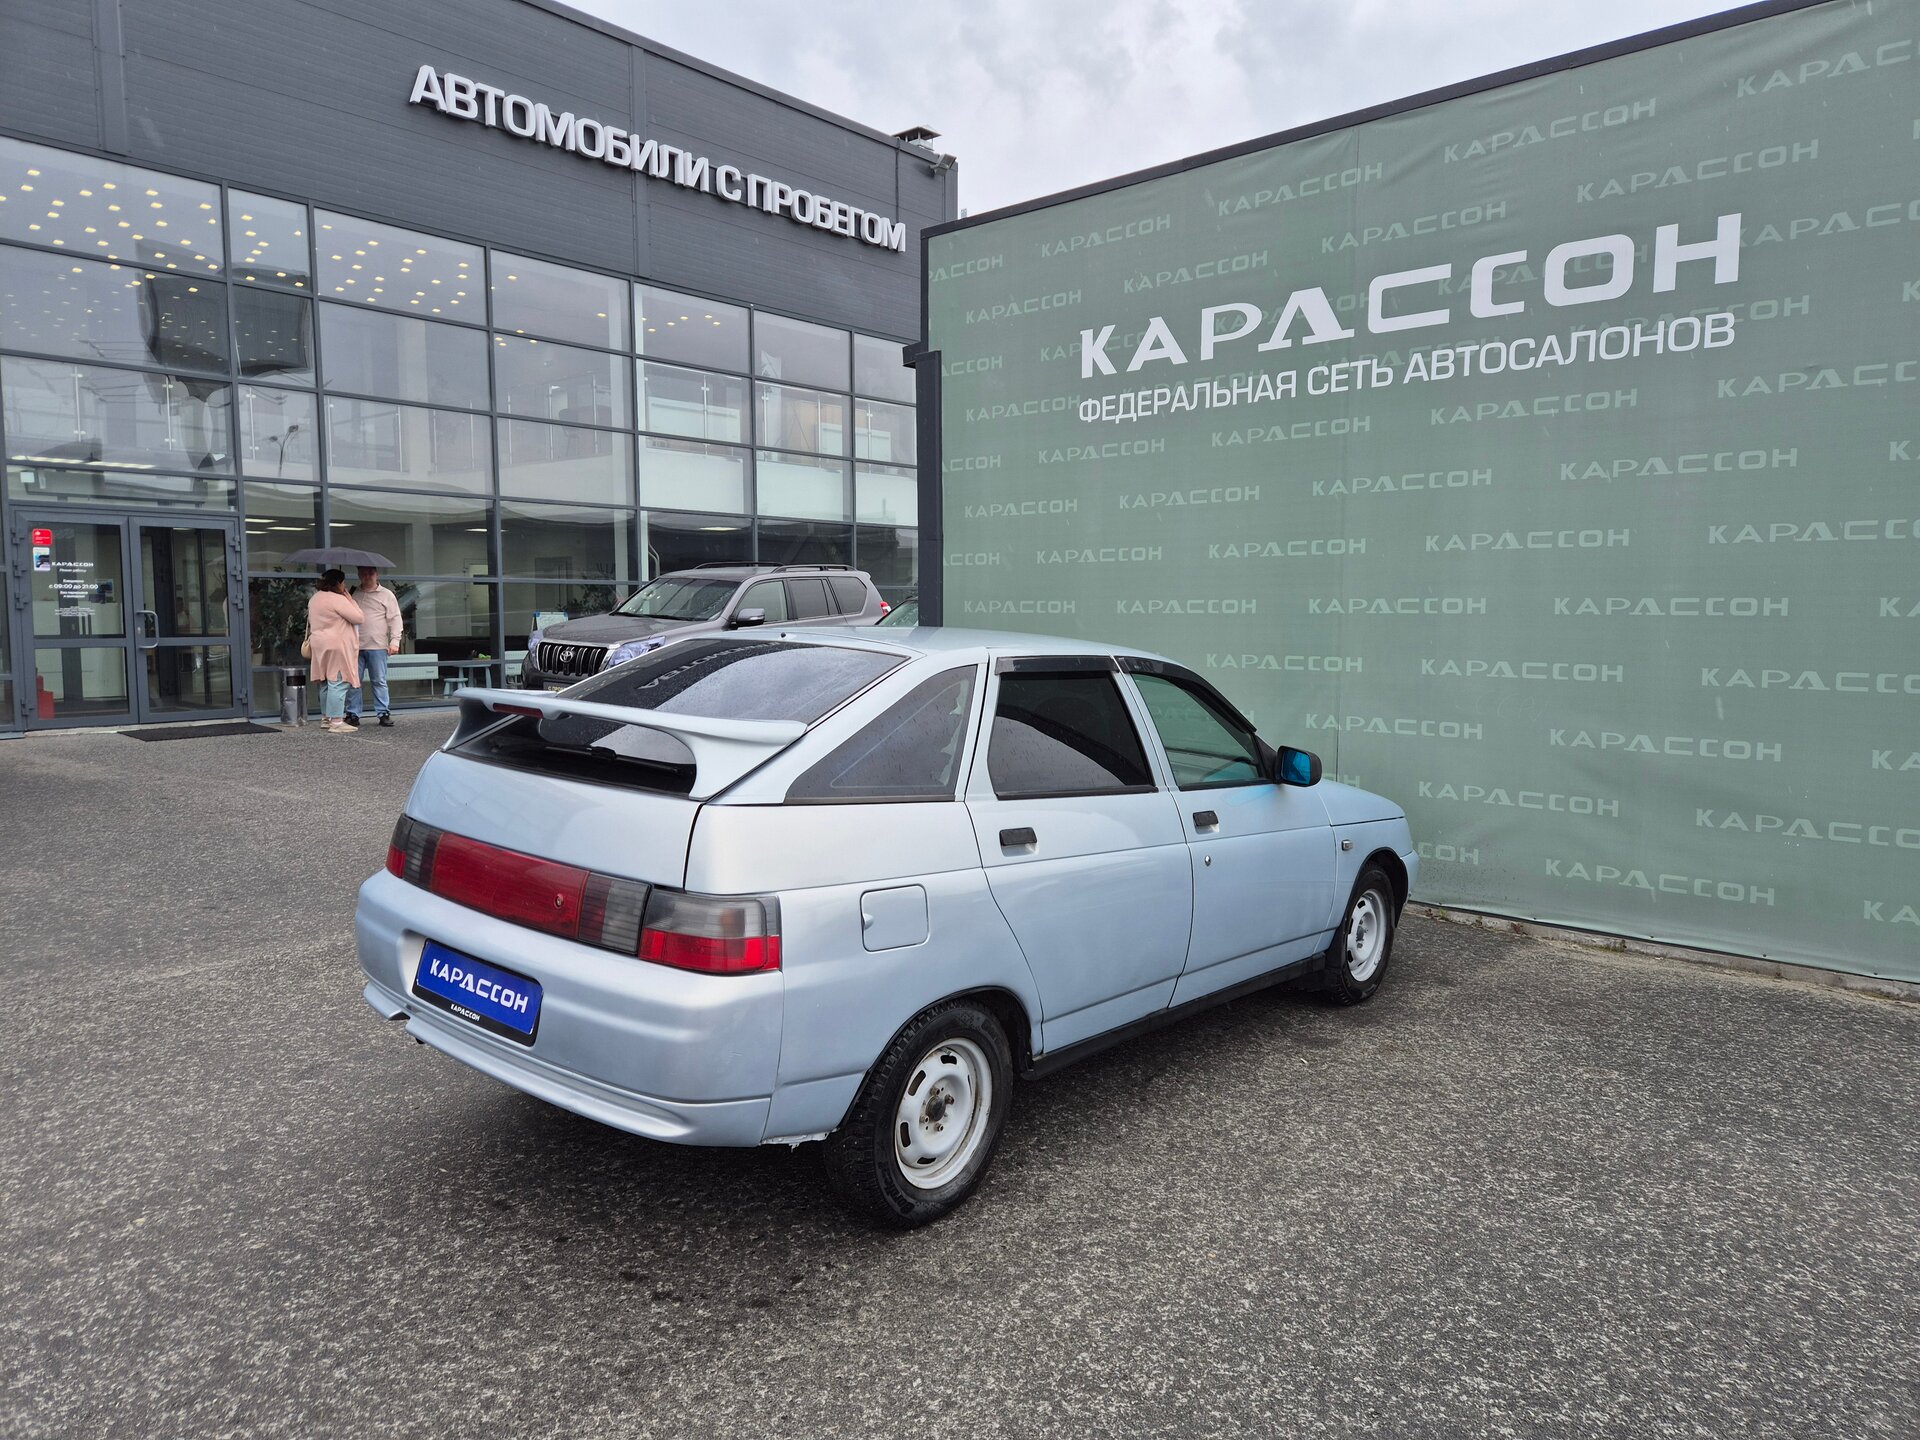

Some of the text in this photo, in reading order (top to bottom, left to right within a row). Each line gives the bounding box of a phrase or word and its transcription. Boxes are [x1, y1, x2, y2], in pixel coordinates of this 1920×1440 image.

[1737, 39, 1920, 98] КАРАС
[409, 64, 906, 252] АВТОМОБИЛИ С ПРОБЕГОМ
[1079, 212, 1742, 379] КАРАССОН
[1079, 312, 1736, 424] ФЕДЕРАЛЬНАЯ СЕТЬ АВТОСАЛОНОВ
[1708, 518, 1920, 544] КАРАСС
[429, 958, 529, 1013] КАРАССОН
